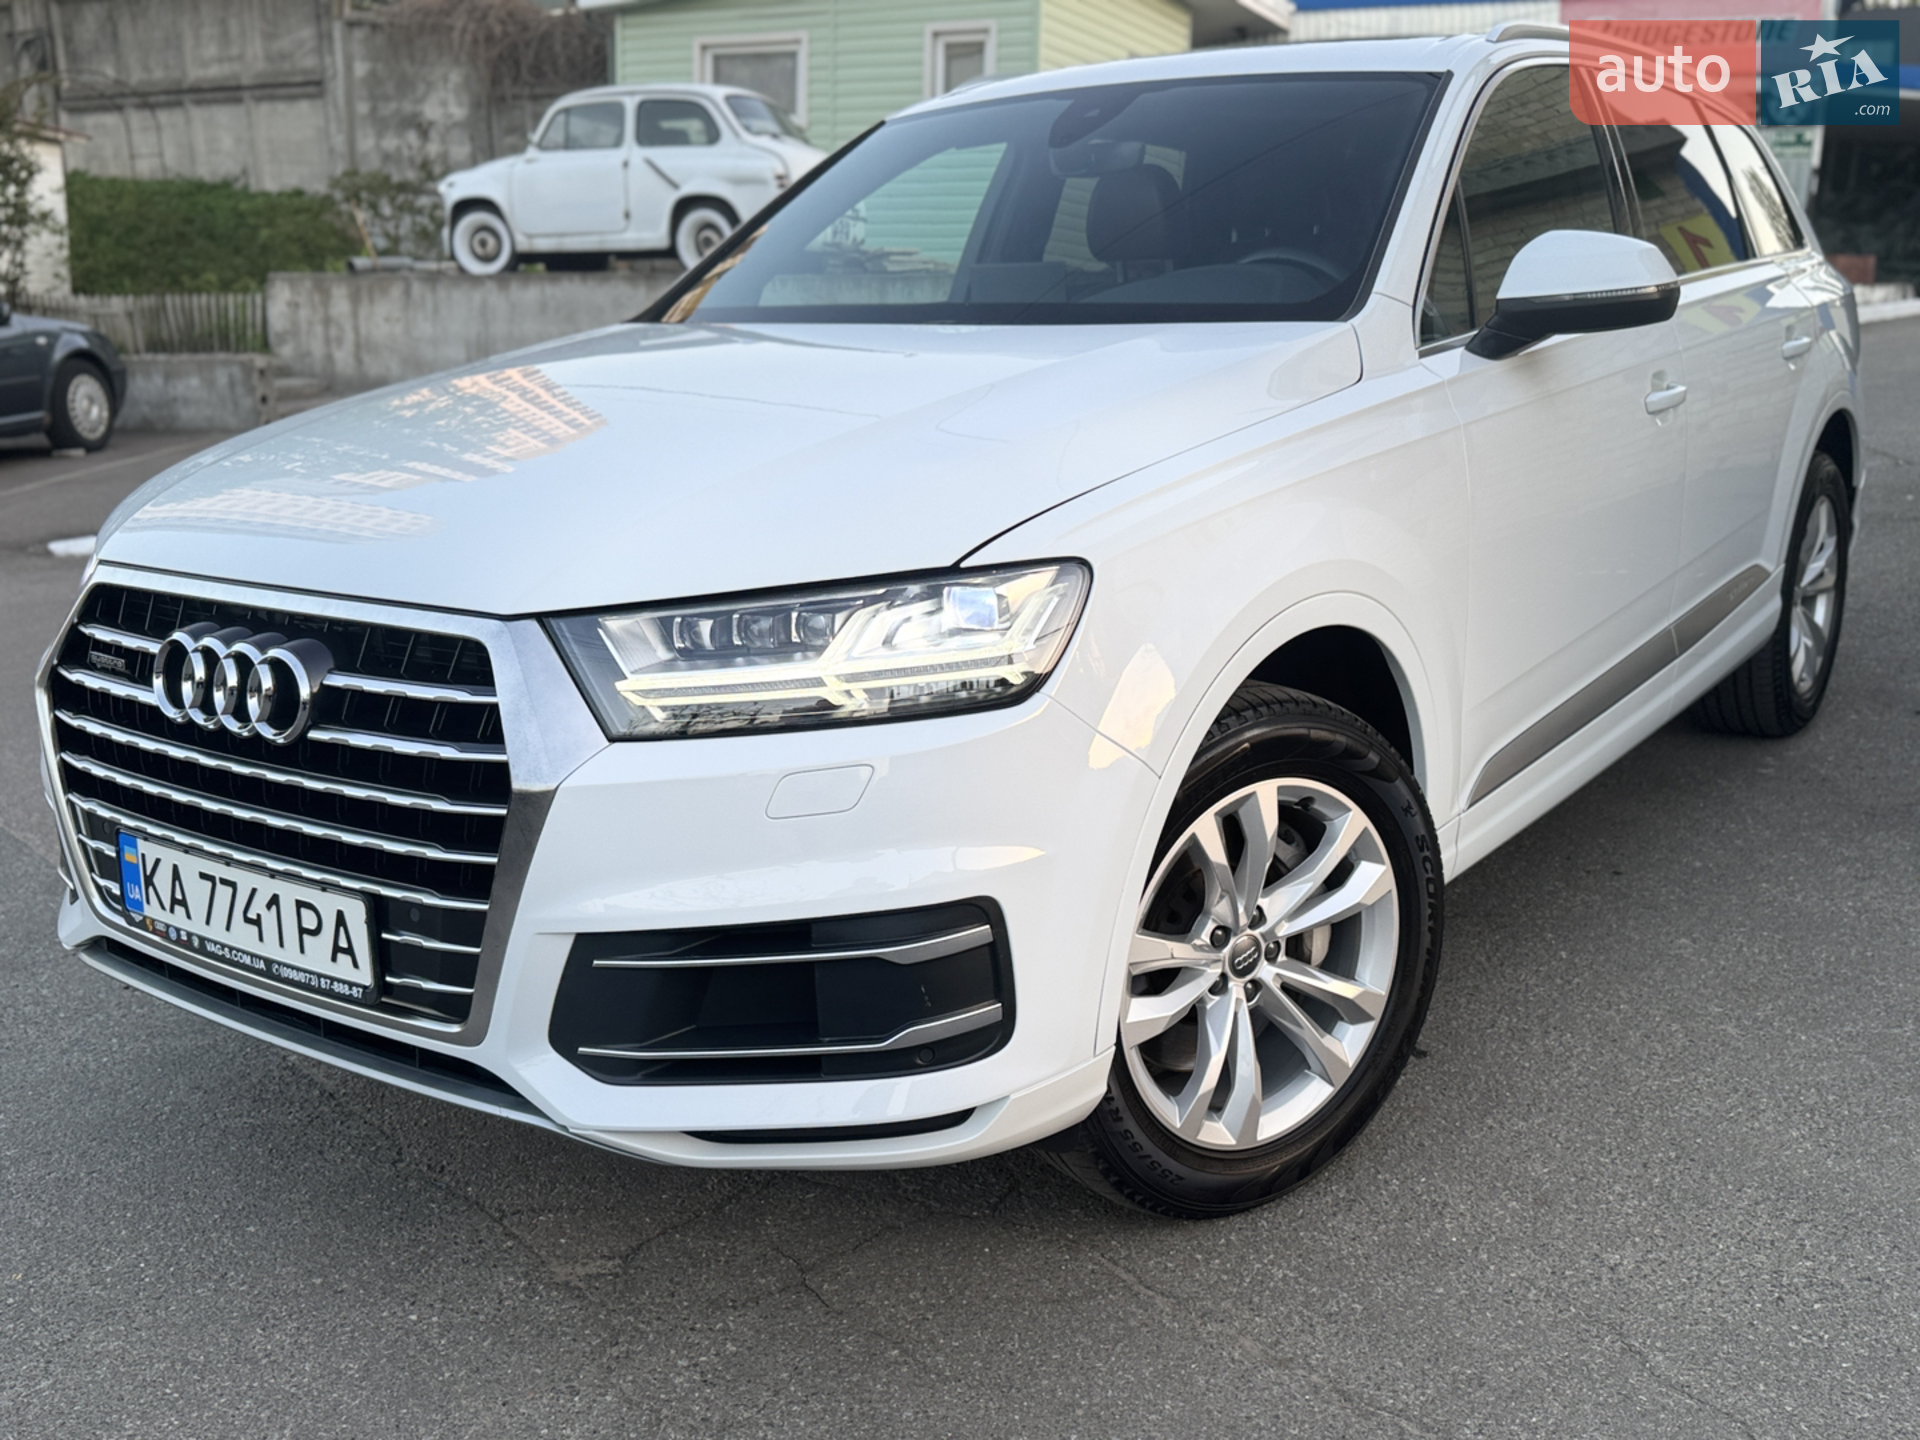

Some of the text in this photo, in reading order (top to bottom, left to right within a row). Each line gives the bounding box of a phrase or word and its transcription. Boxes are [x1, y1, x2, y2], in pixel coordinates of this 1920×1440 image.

[127, 882, 142, 902] UA
[204, 940, 266, 971] VAG-S.COM.UA
[1119, 1129, 1185, 1186] 255/55
